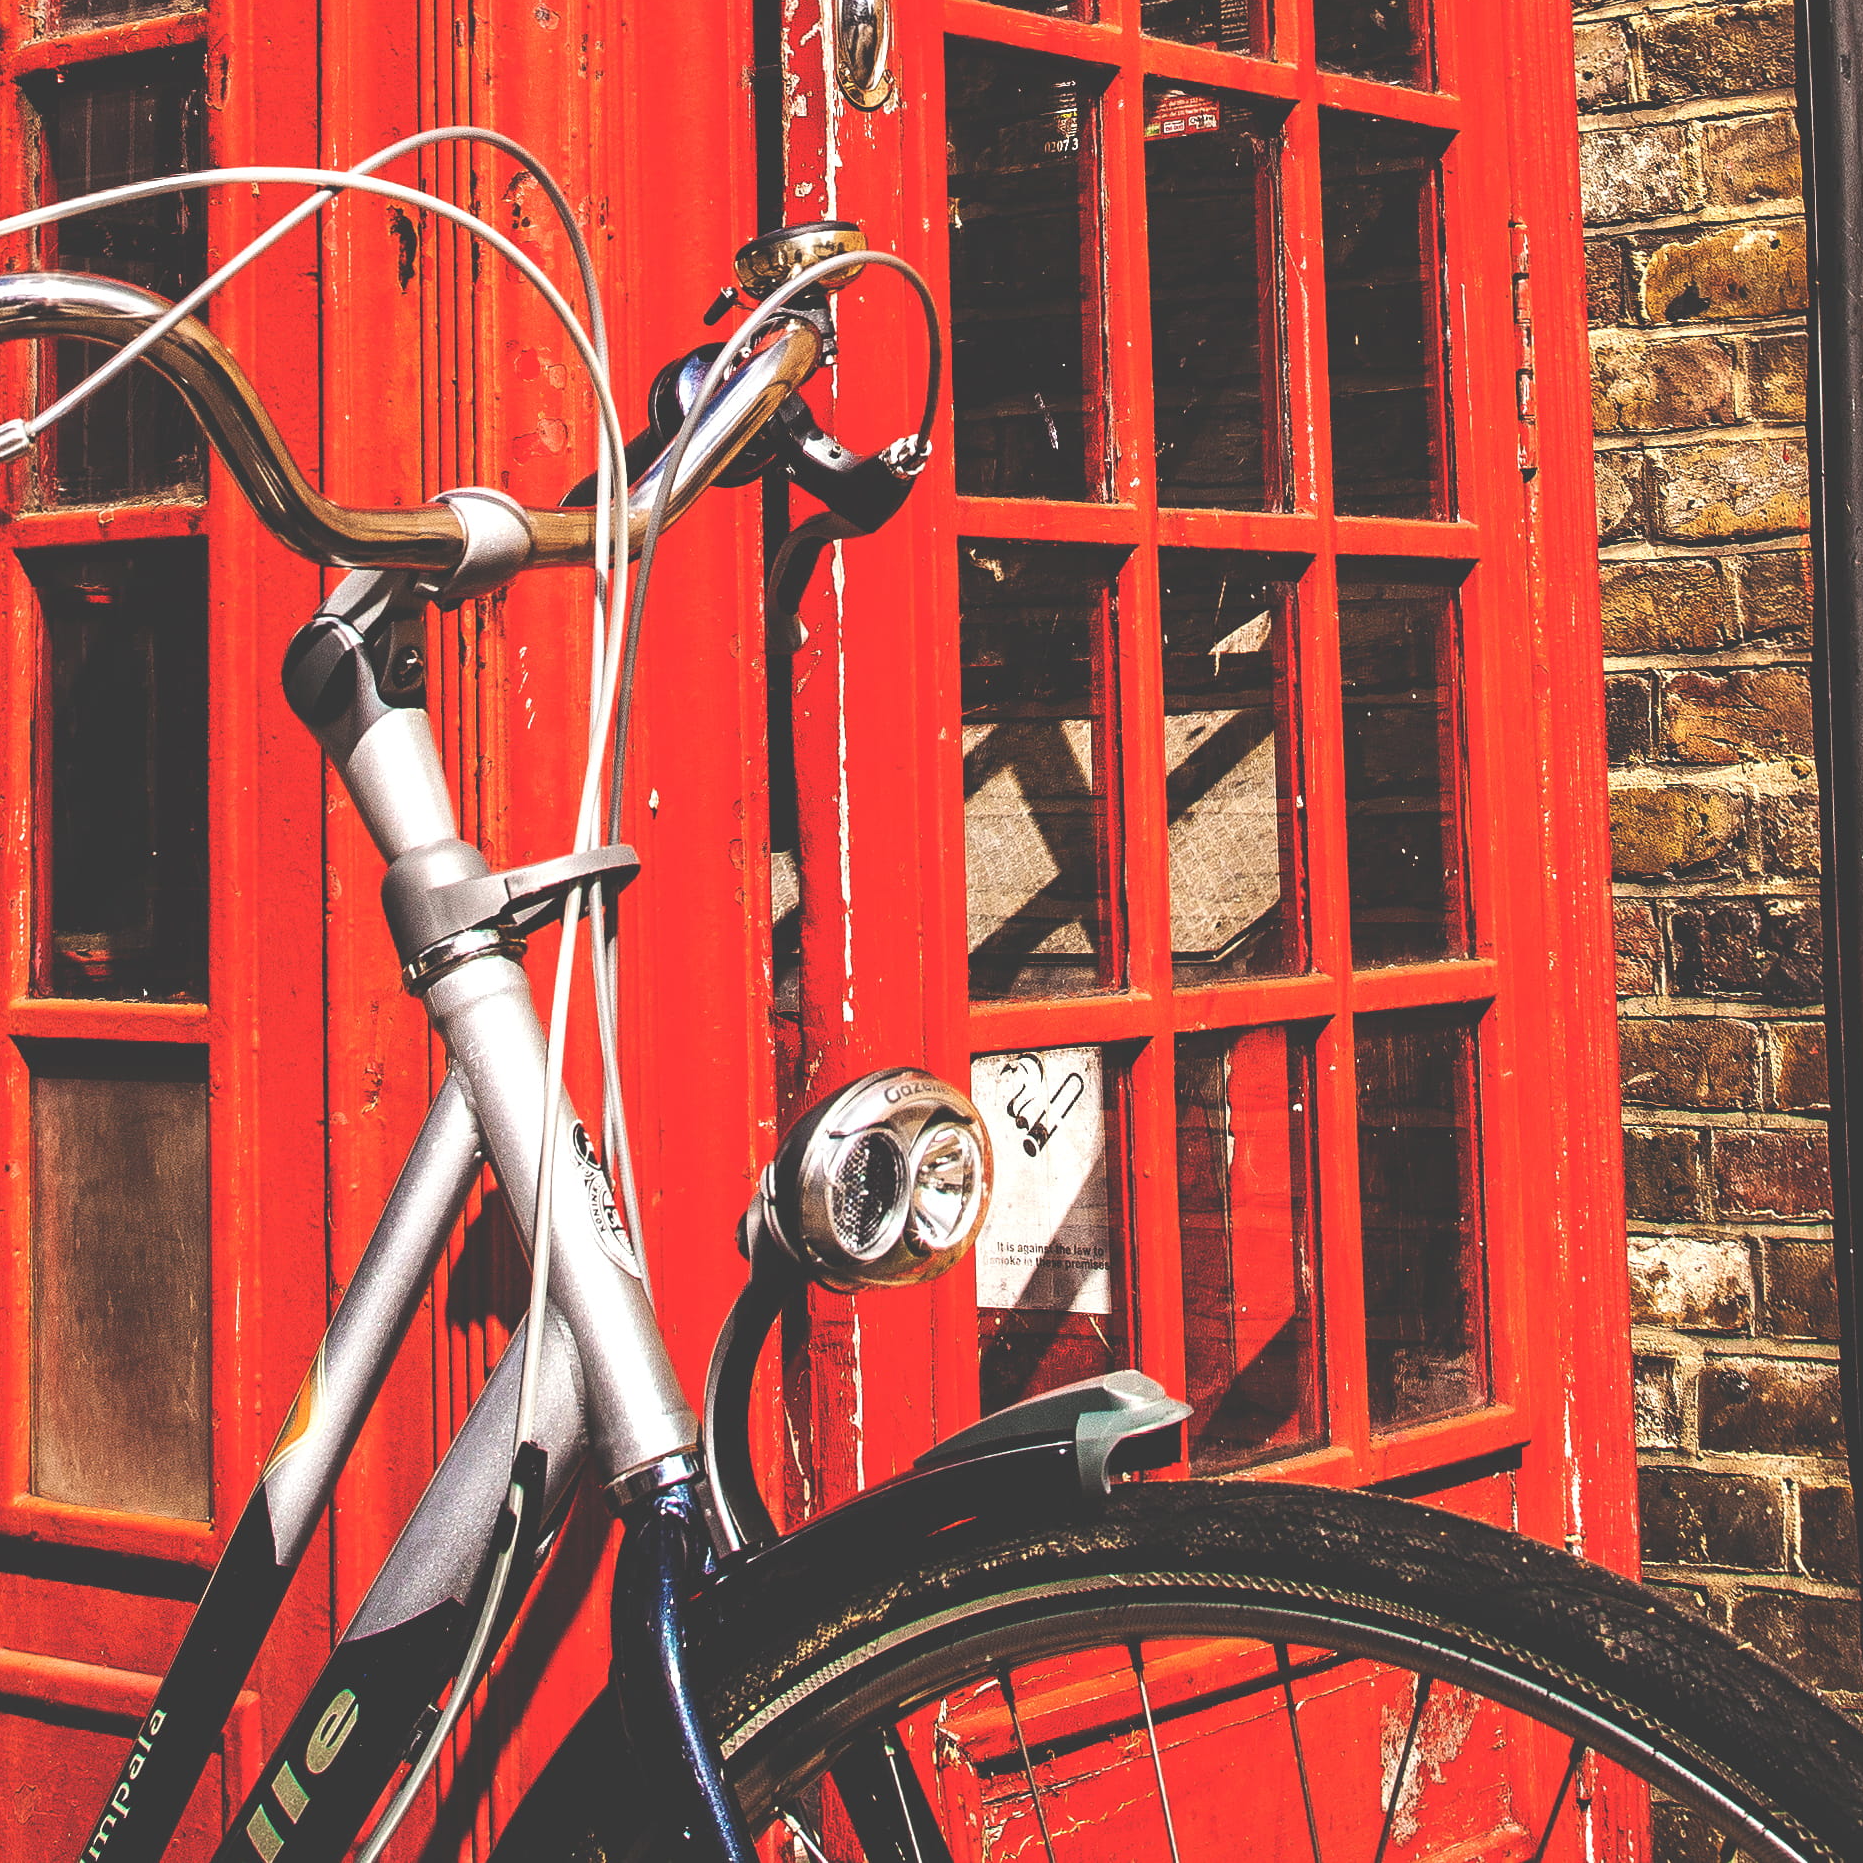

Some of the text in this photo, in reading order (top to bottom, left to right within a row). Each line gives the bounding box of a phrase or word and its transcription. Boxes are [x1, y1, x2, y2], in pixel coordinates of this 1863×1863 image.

[997, 1241, 1105, 1257] It is against the law to
[1035, 1257, 1062, 1269] these
[1064, 1258, 1111, 1271] premises
